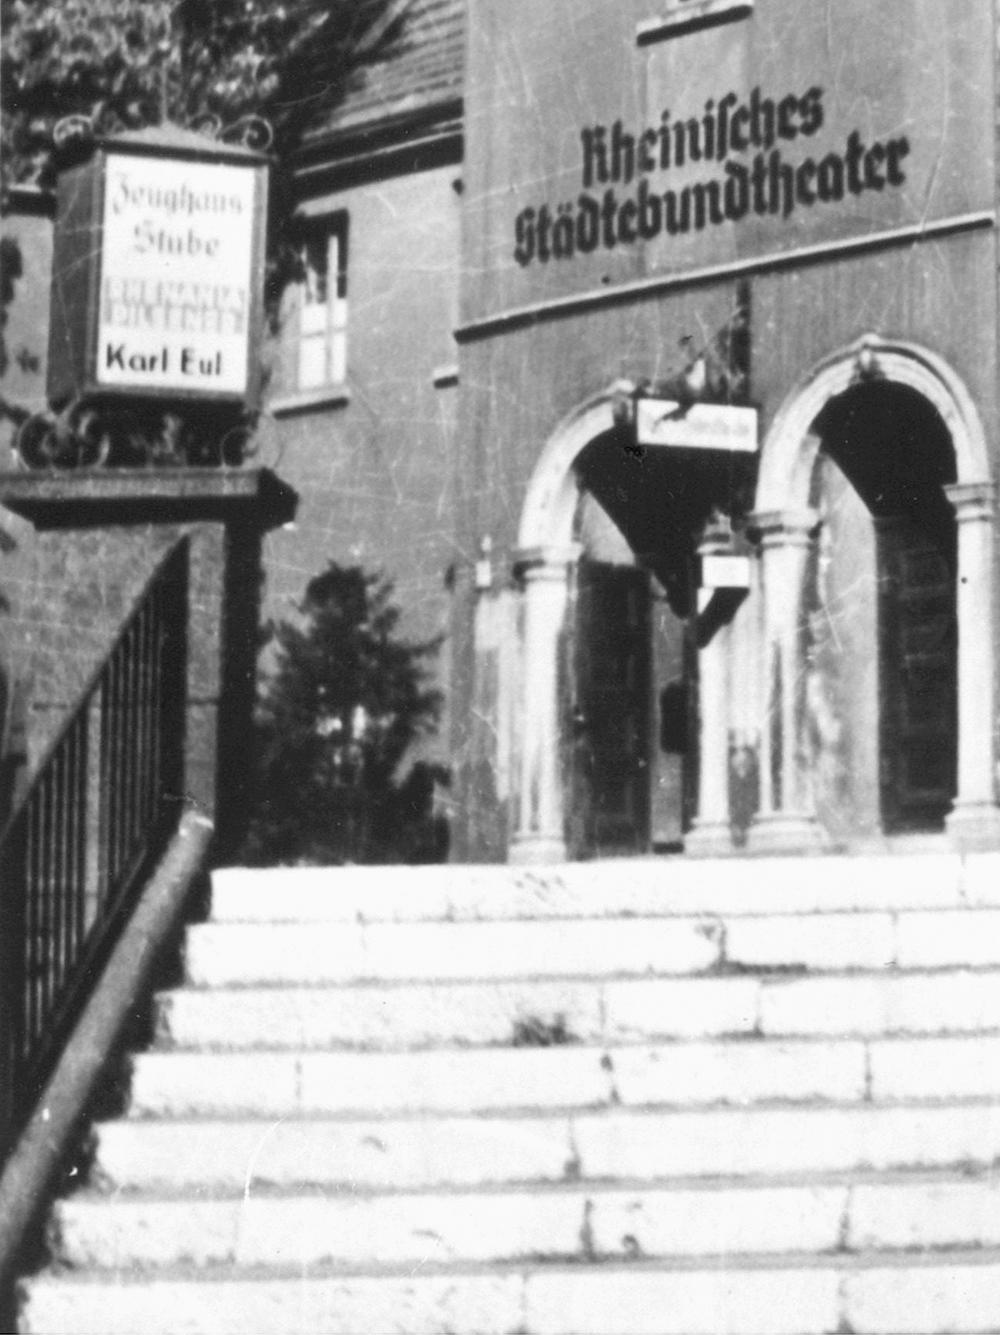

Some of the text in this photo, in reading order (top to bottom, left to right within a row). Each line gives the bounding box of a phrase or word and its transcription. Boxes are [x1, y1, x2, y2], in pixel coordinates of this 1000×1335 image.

[112, 171, 243, 216] Zeughaus
[514, 130, 910, 268] Städtebundtheater
[133, 218, 220, 257] Stube
[105, 343, 222, 376] Karl Eul
